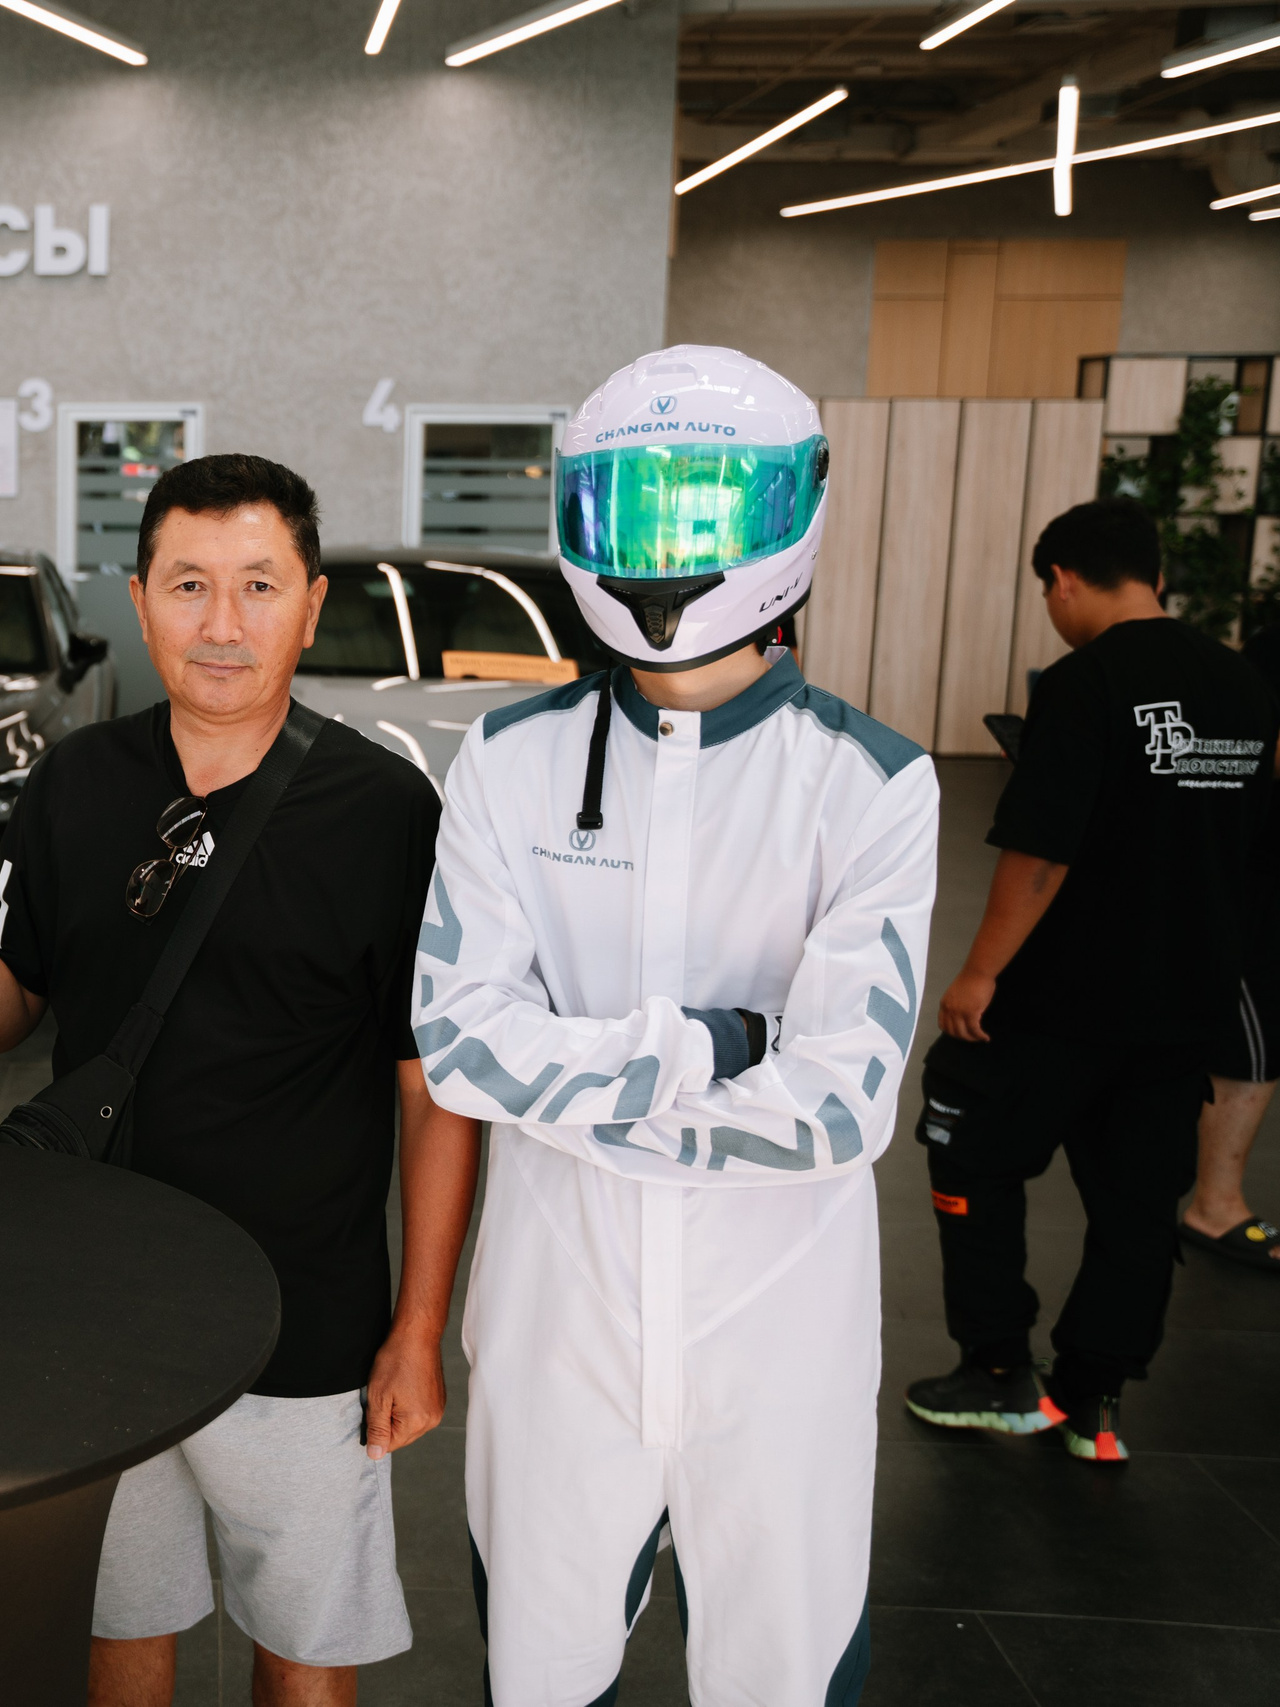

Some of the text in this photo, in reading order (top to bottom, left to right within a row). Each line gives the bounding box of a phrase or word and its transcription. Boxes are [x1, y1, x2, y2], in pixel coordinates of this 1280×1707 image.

[18, 378, 53, 432] 3
[362, 378, 401, 433] 4
[595, 421, 737, 444] CHANGAN AUTO
[599, 858, 635, 872] AUT
